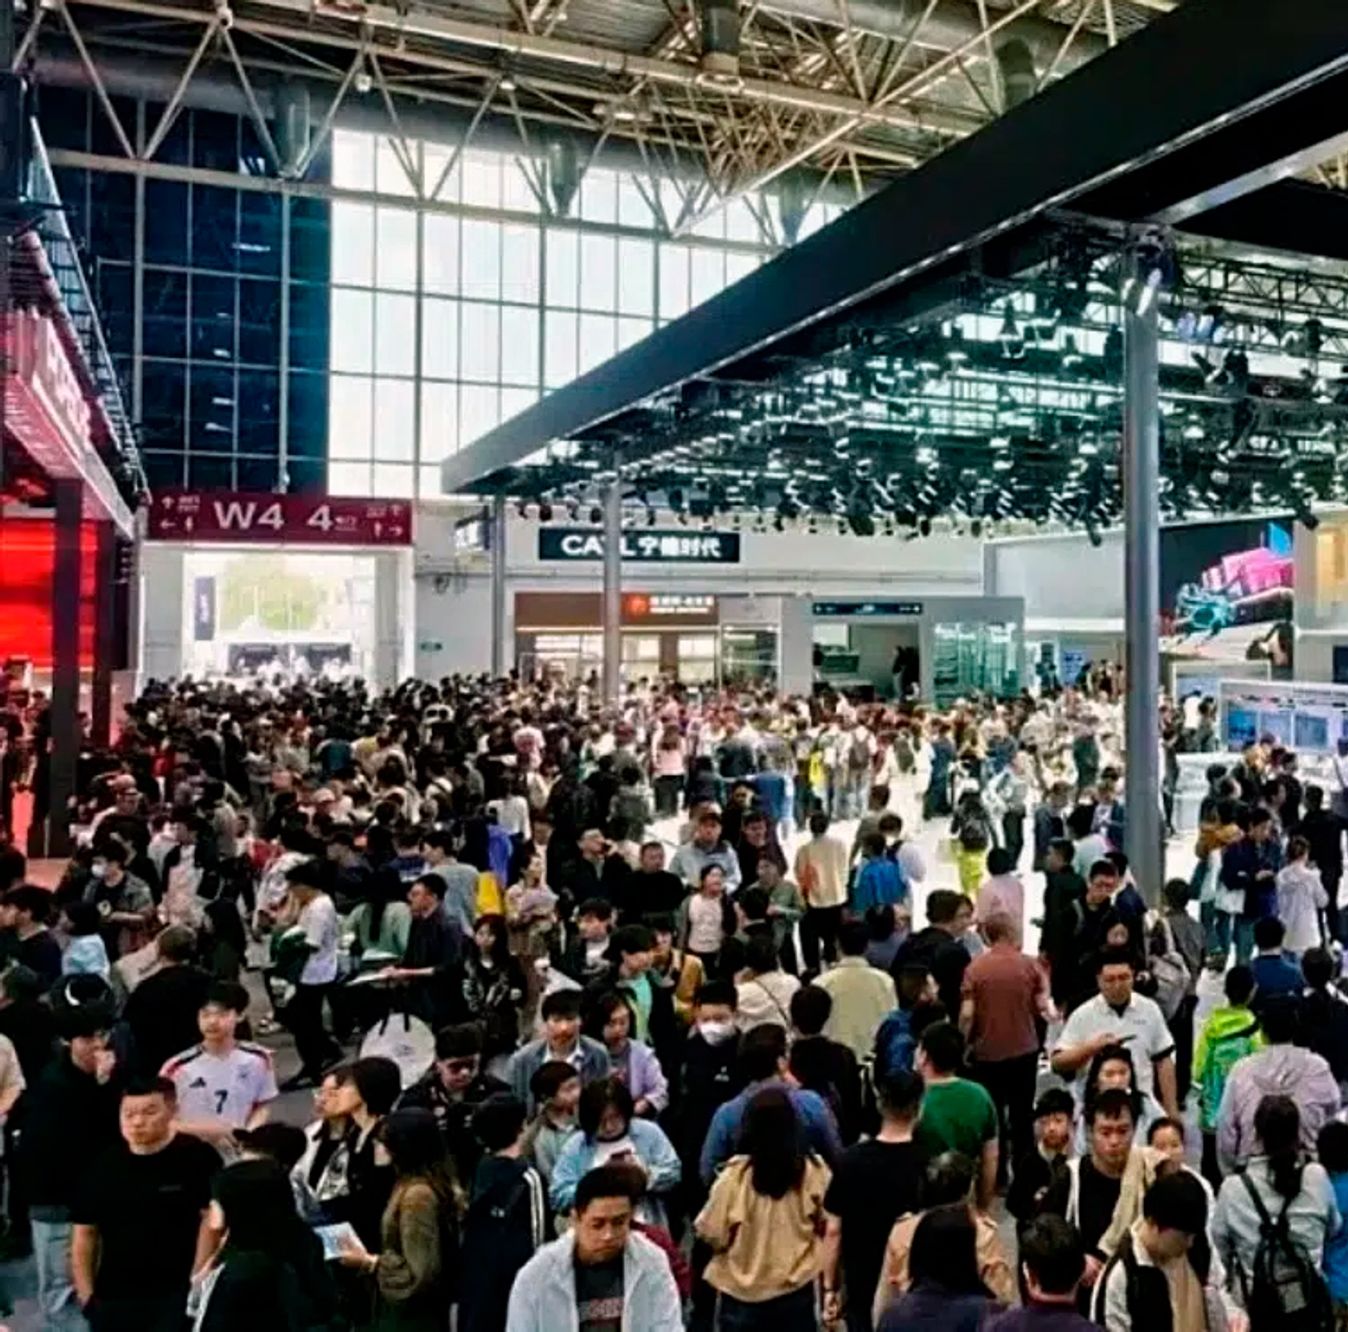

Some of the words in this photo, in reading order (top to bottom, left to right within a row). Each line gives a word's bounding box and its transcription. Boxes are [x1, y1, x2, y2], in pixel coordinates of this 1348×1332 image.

[213, 501, 284, 530] W4
[306, 504, 333, 531] 4
[561, 535, 636, 556] CAL
[214, 1089, 229, 1114] 7
